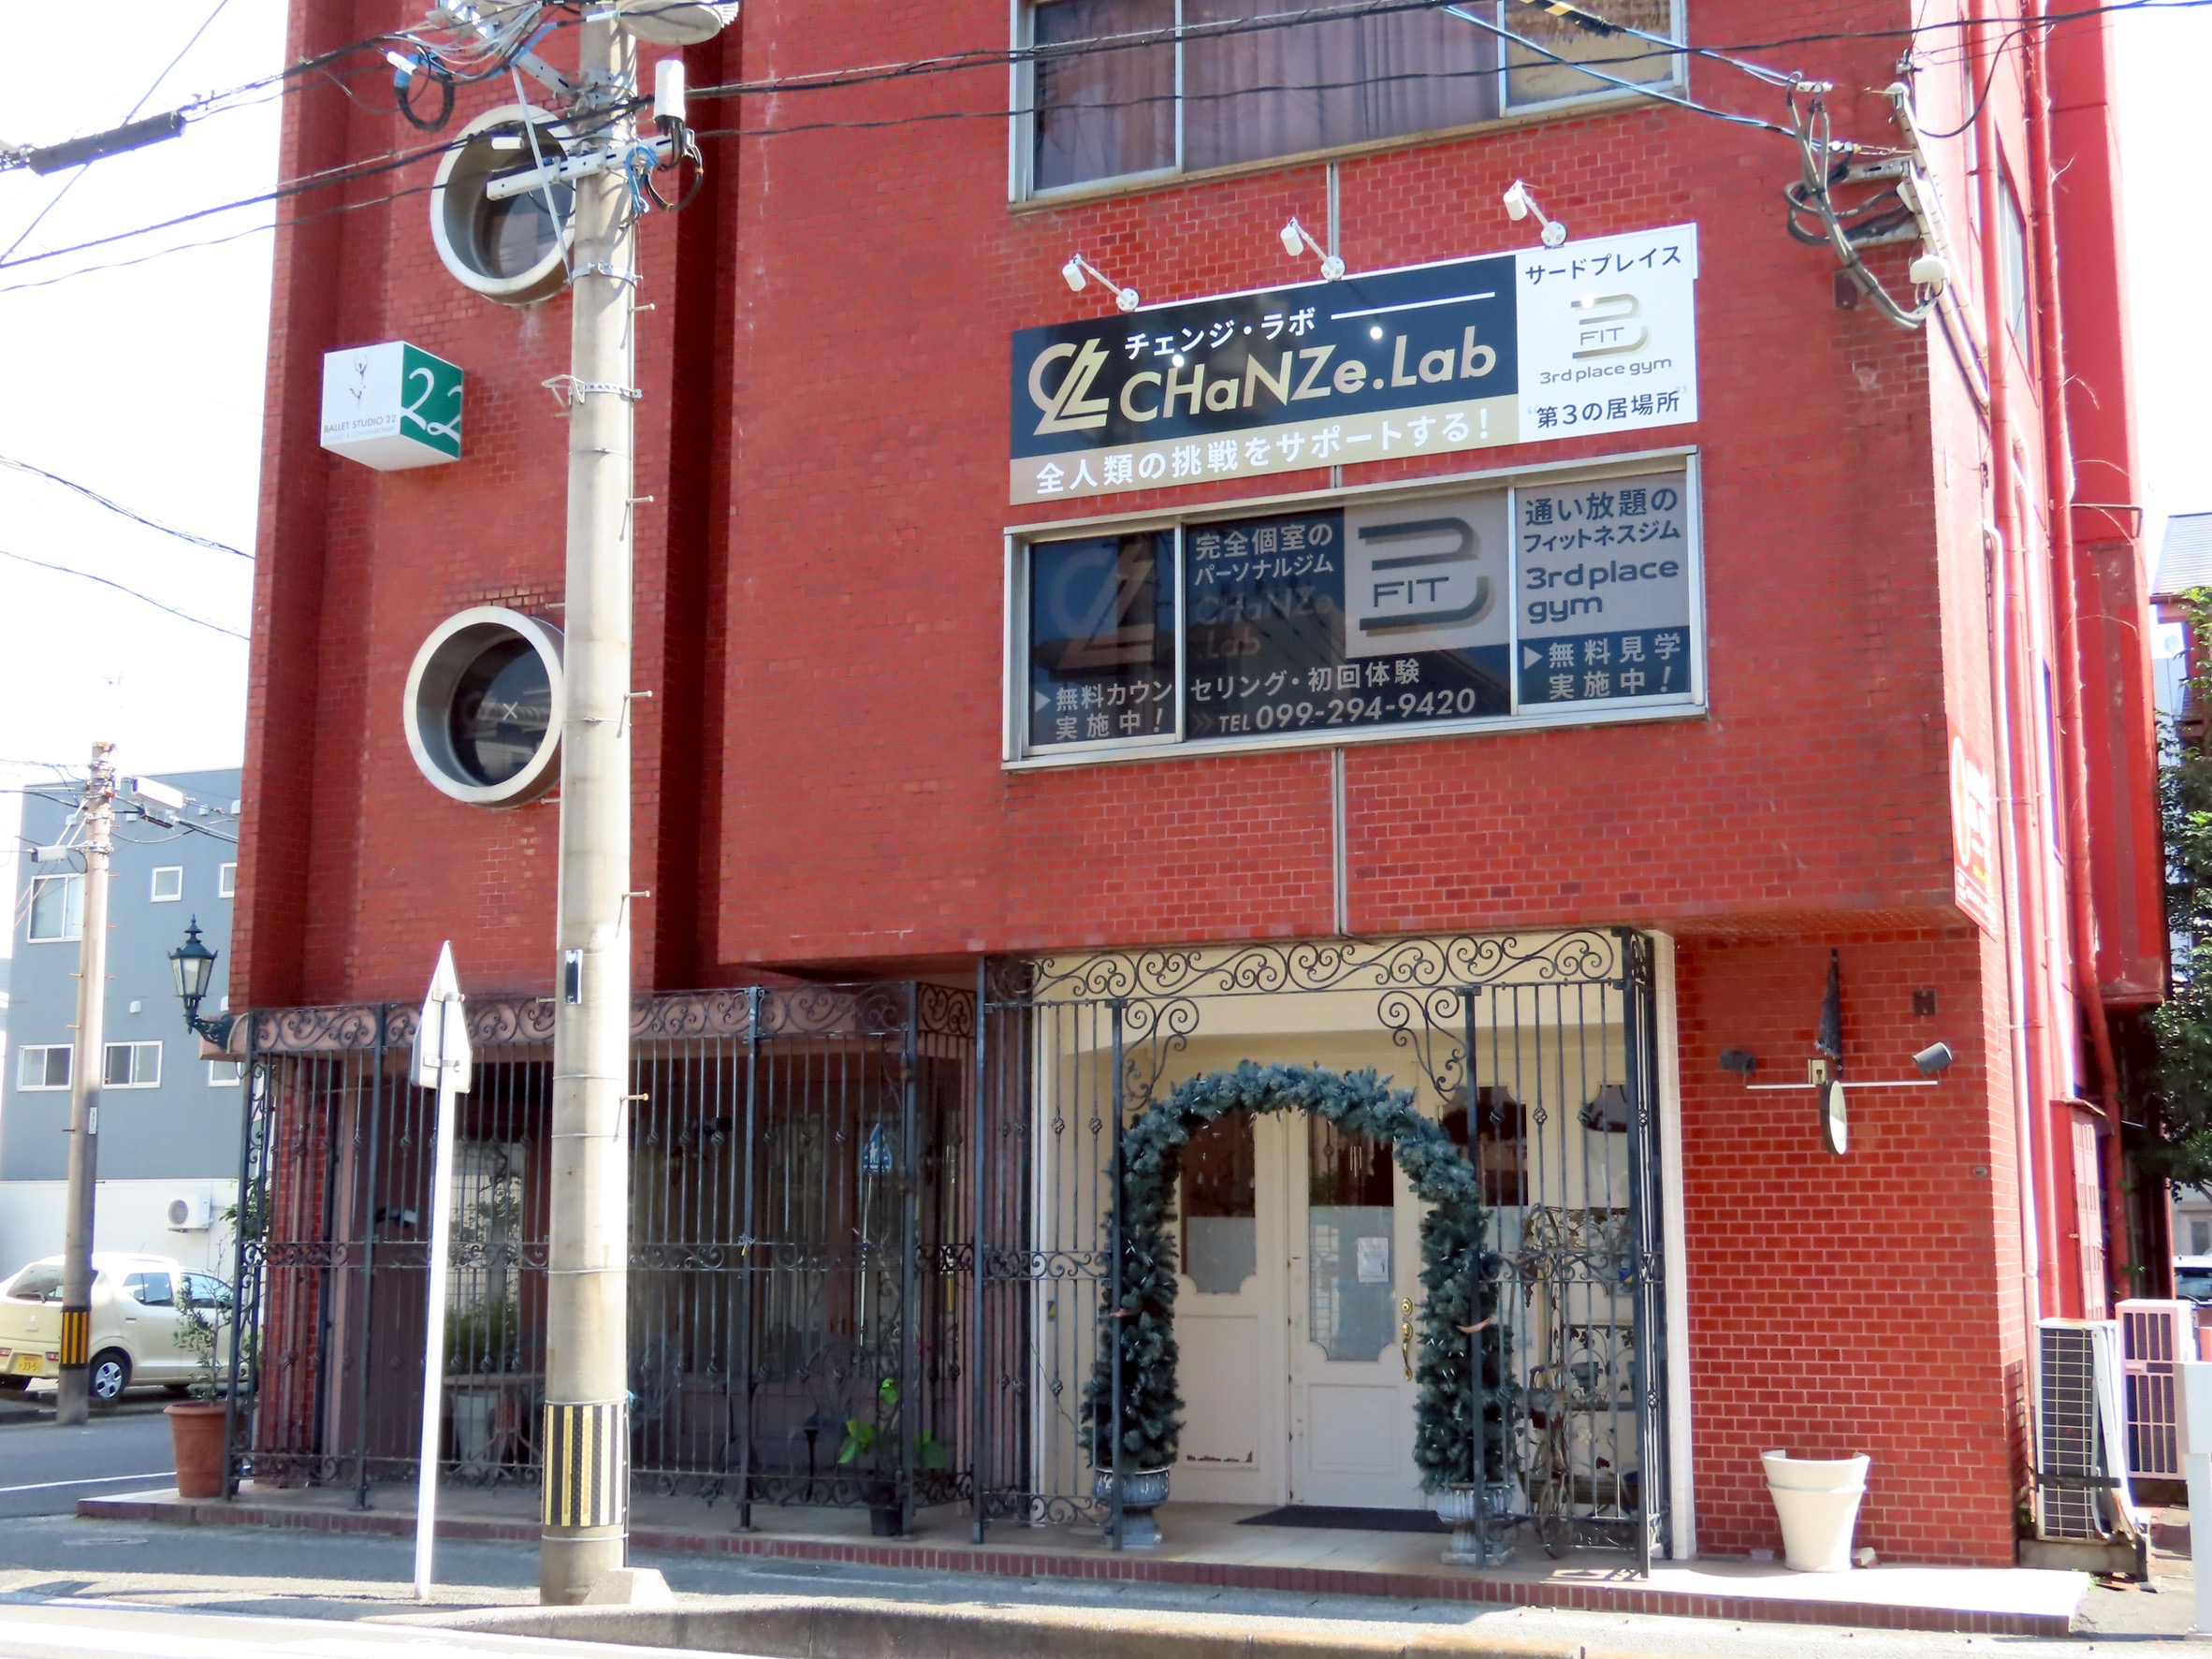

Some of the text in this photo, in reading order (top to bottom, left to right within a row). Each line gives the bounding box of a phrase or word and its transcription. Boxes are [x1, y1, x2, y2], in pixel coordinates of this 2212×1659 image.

[1525, 246, 1681, 285] サードプレイス
[1125, 306, 1316, 360] チェンジ・ラボ
[1579, 327, 1624, 346] FIT
[1120, 326, 1496, 422] CHaNZe.Lab
[1539, 358, 1672, 385] 3rd place gym
[324, 421, 350, 433] BALLET
[352, 416, 384, 429] STUDIO
[386, 414, 398, 424] 22
[1526, 488, 1678, 526] 通い放題の
[1195, 523, 1332, 560] 完全個室の
[1524, 520, 1681, 554] フィットネスジム
[1194, 553, 1334, 586] パーソナルジム
[1526, 560, 1679, 589] 3rd place
[1374, 576, 1449, 607] FIT
[1527, 595, 1603, 624] gym
[1549, 633, 1681, 669] 無料見学
[1219, 688, 1476, 733] TEL 099-294-9420
